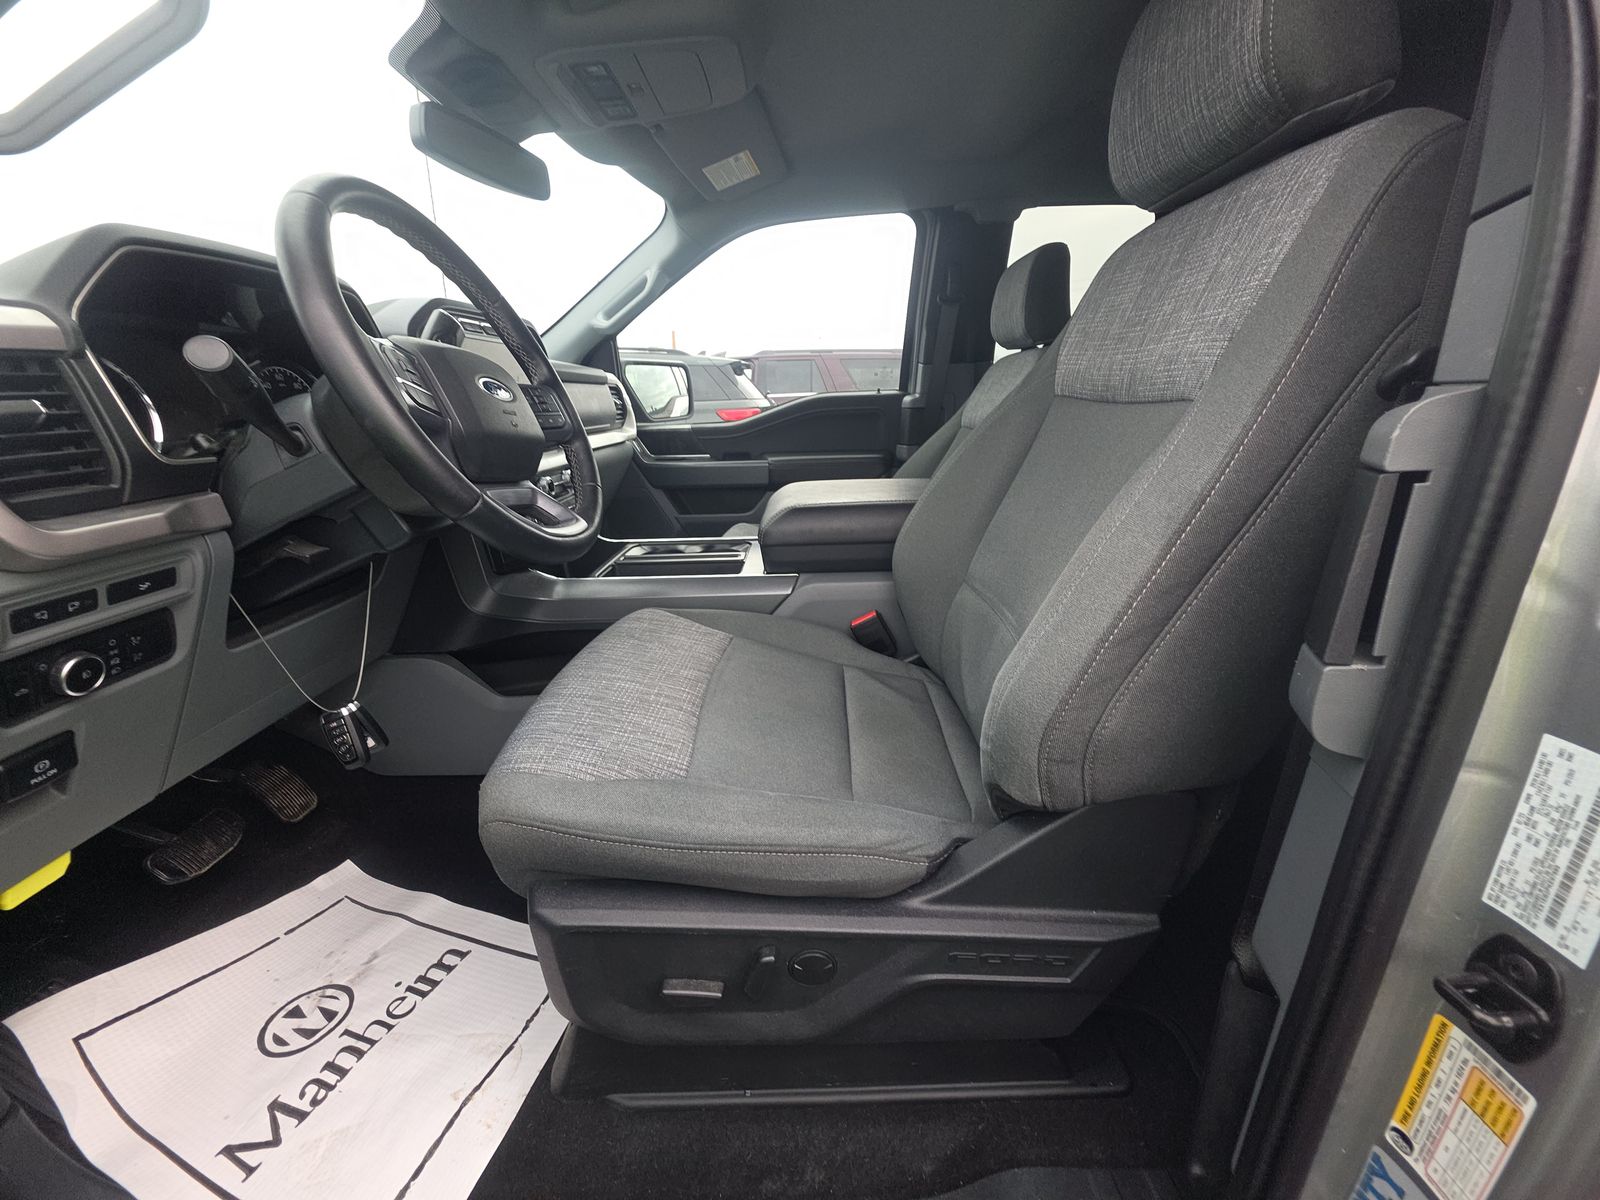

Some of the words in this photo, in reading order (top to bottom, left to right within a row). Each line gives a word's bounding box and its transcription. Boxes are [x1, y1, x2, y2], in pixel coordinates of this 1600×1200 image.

[30, 774, 47, 785] PULL
[46, 768, 58, 777] ON
[215, 948, 472, 1183] Manheim
[1400, 1109, 1411, 1127] TIRE
[1407, 1095, 1417, 1110] AND
[1413, 1067, 1430, 1098] LOADING
[1424, 1020, 1449, 1068] INFORMATION
